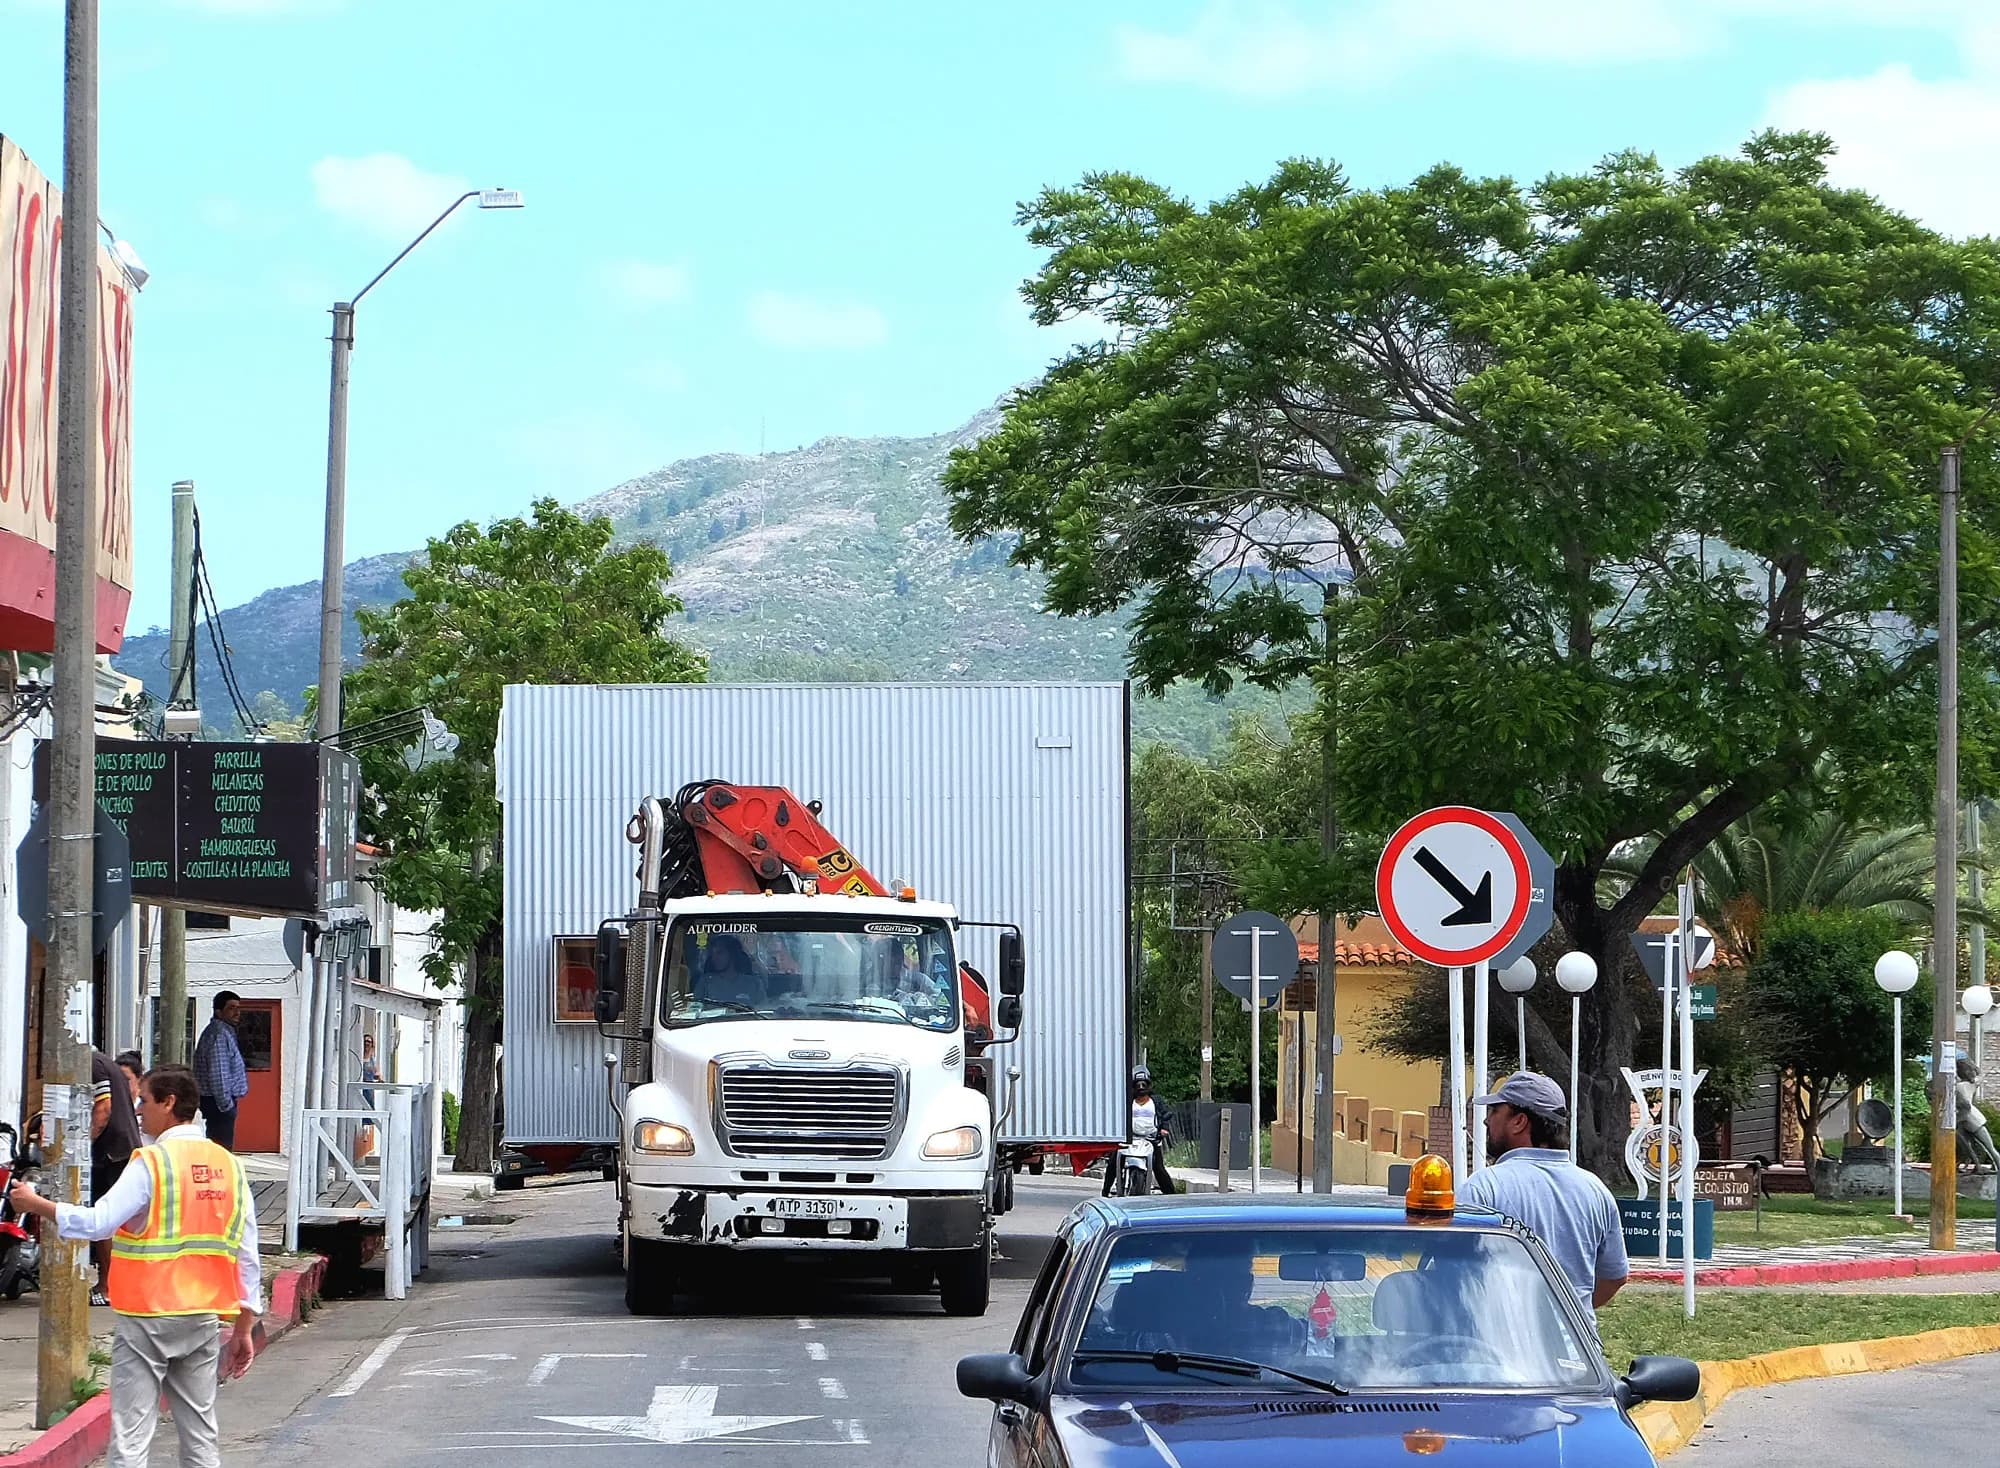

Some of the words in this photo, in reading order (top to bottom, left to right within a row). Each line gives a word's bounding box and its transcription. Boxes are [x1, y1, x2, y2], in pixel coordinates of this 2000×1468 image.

[119, 753, 133, 770] DE
[135, 751, 166, 770] POLLO
[214, 751, 261, 769] PARRILLA
[106, 775, 119, 791] DE
[121, 774, 152, 792] POLLO
[211, 772, 264, 790] MILANESAS
[215, 794, 261, 812] CHIVITOS
[221, 814, 255, 834] BAURÚ
[200, 838, 276, 857] HAMBURGUESAS
[130, 861, 168, 878] LIENTES
[186, 861, 229, 878] COSTILLAS
[231, 861, 238, 877] A
[239, 860, 250, 877] LA
[251, 860, 290, 878] PLANCHA
[685, 923, 758, 935] AUTOLIDER
[869, 923, 917, 933] FREIGHTLINER
[1694, 1171, 1736, 1181] AZOLETA
[779, 1200, 801, 1213] ATP
[805, 1201, 834, 1214] 3130
[1641, 1211, 1652, 1219] DE
